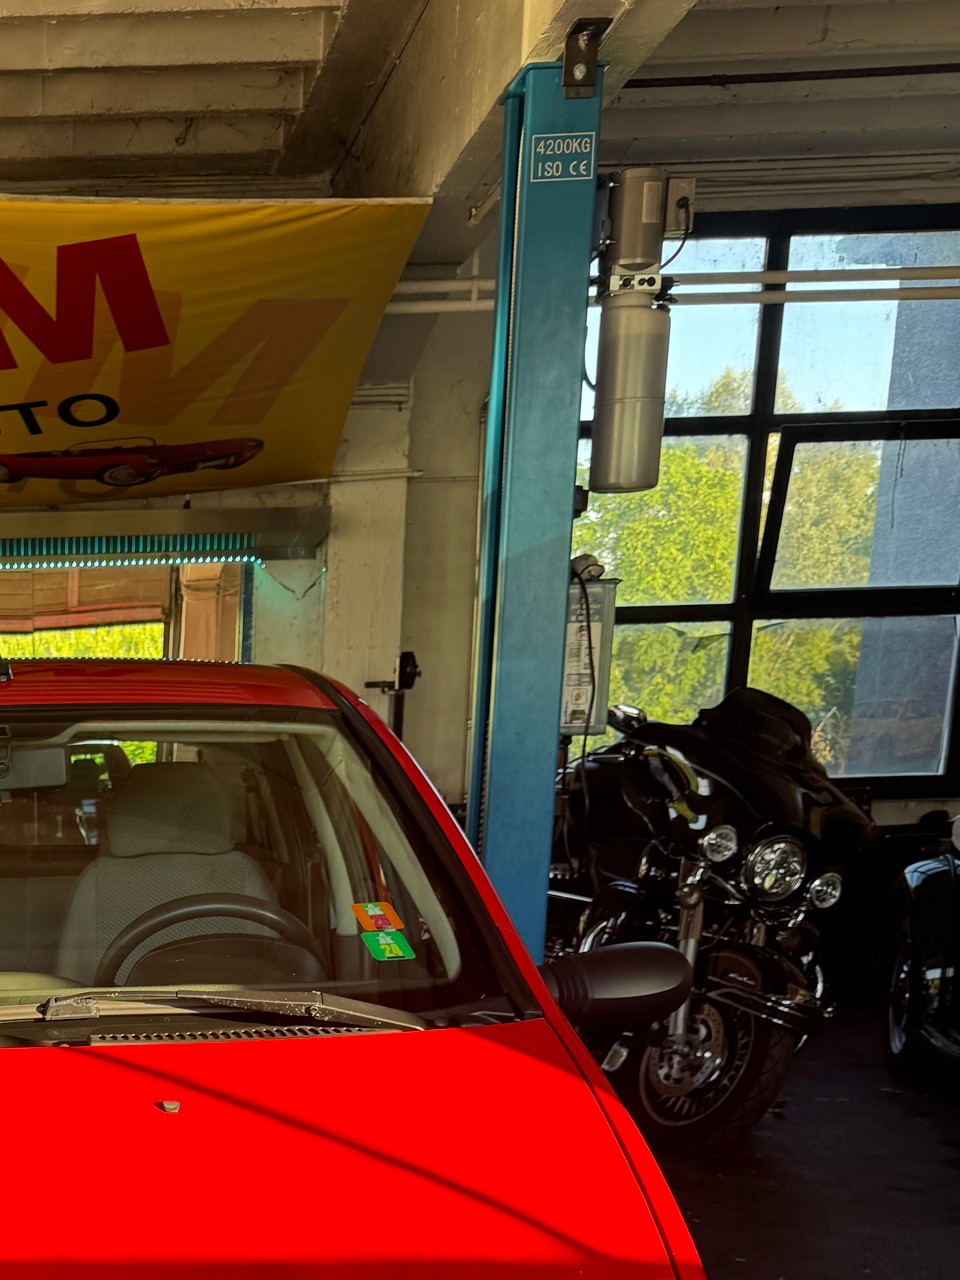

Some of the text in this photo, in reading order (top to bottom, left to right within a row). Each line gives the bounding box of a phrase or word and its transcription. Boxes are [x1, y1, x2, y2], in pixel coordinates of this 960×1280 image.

[536, 137, 591, 155] 4200KG
[538, 161, 562, 177] ISO
[380, 943, 404, 957] 24
